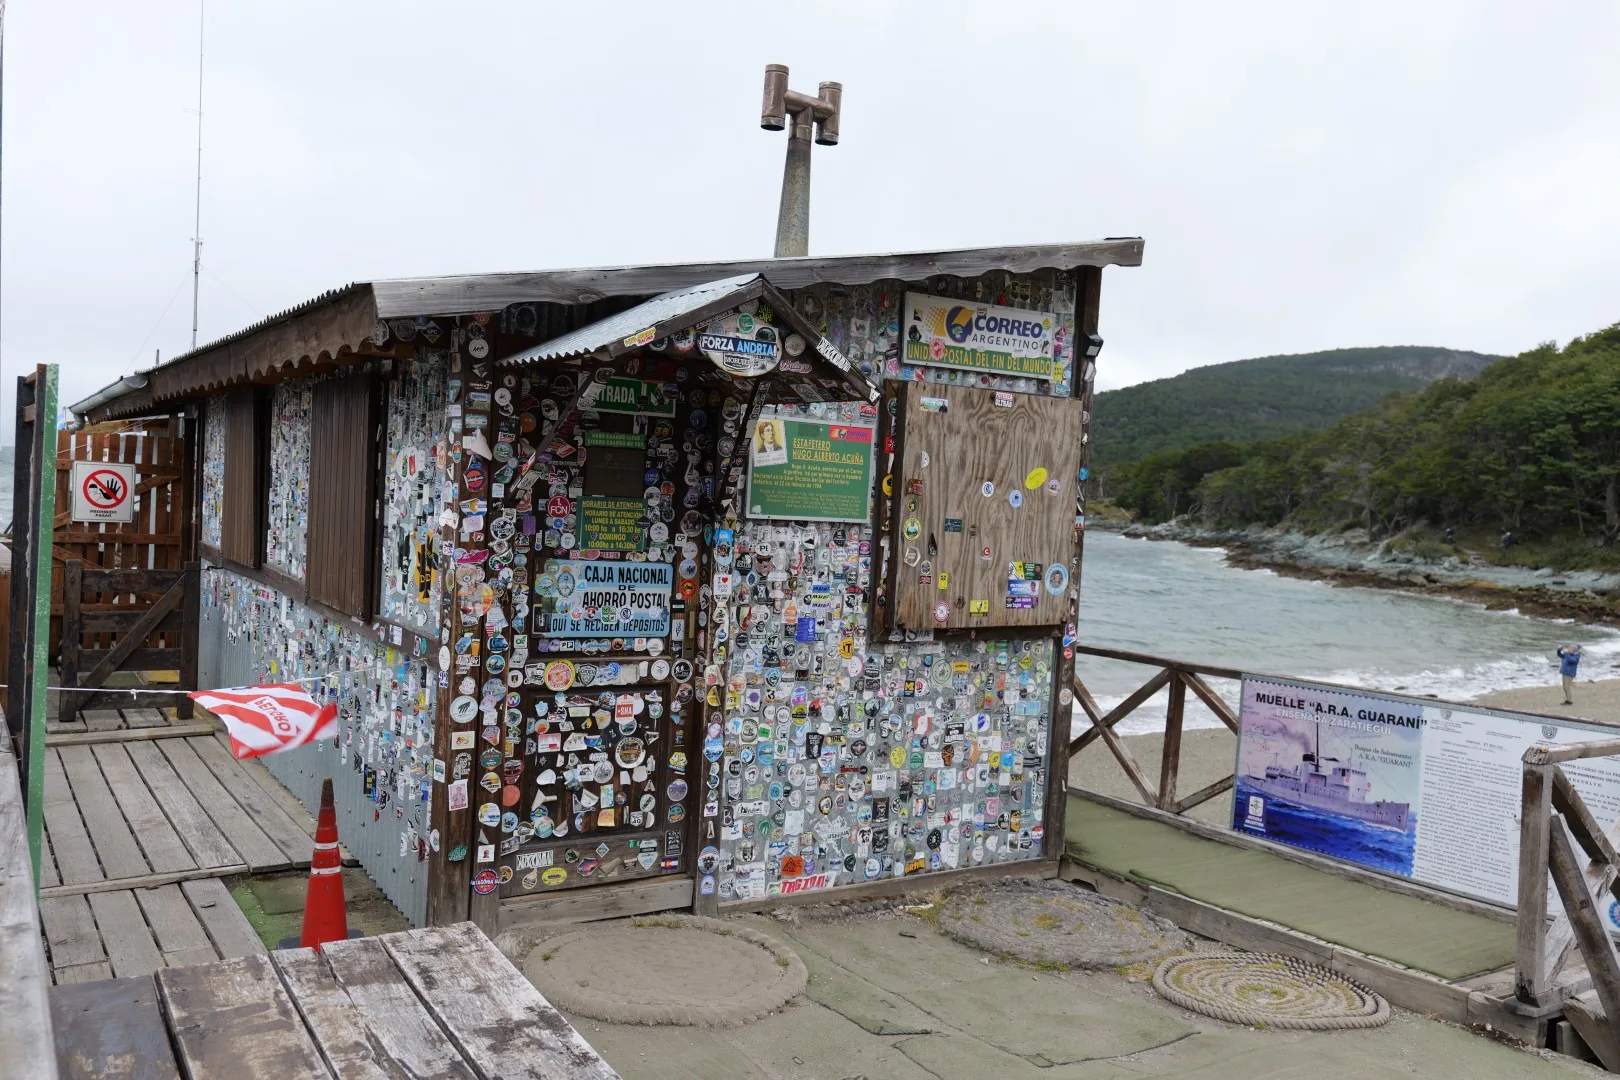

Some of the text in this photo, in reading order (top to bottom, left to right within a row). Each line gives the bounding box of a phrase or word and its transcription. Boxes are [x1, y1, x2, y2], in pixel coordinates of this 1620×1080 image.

[974, 314, 1043, 338] CORREO
[702, 334, 778, 357] FORZA ANDRIA!
[972, 334, 1038, 350] ARGENTINO
[944, 350, 973, 366] POSTAL
[976, 352, 989, 368] DEL
[992, 354, 1004, 369] FIN
[1008, 356, 1020, 371] DEL
[1022, 358, 1051, 374] MUNDO
[599, 384, 636, 404] TRADA
[793, 438, 831, 450] ESTAFETERO
[792, 449, 812, 460] HUGO
[814, 450, 840, 462] ALBERTO
[842, 452, 864, 464] ACUÑA
[550, 506, 568, 514] FCN
[598, 532, 626, 541] DOMINGO
[584, 566, 669, 584] CAJA NACIONAL
[582, 592, 666, 609] AHORRO POSTAL
[552, 616, 665, 632] QUÍ SE RECIBEN DEPÓSITOS
[1256, 692, 1306, 710] MUELLE
[1358, 710, 1428, 730] GUARANÍ”
[1276, 708, 1392, 736] ENSENADA ZARATIEGUI
[1354, 744, 1372, 754] Buque
[1380, 749, 1412, 760] Salvamento
